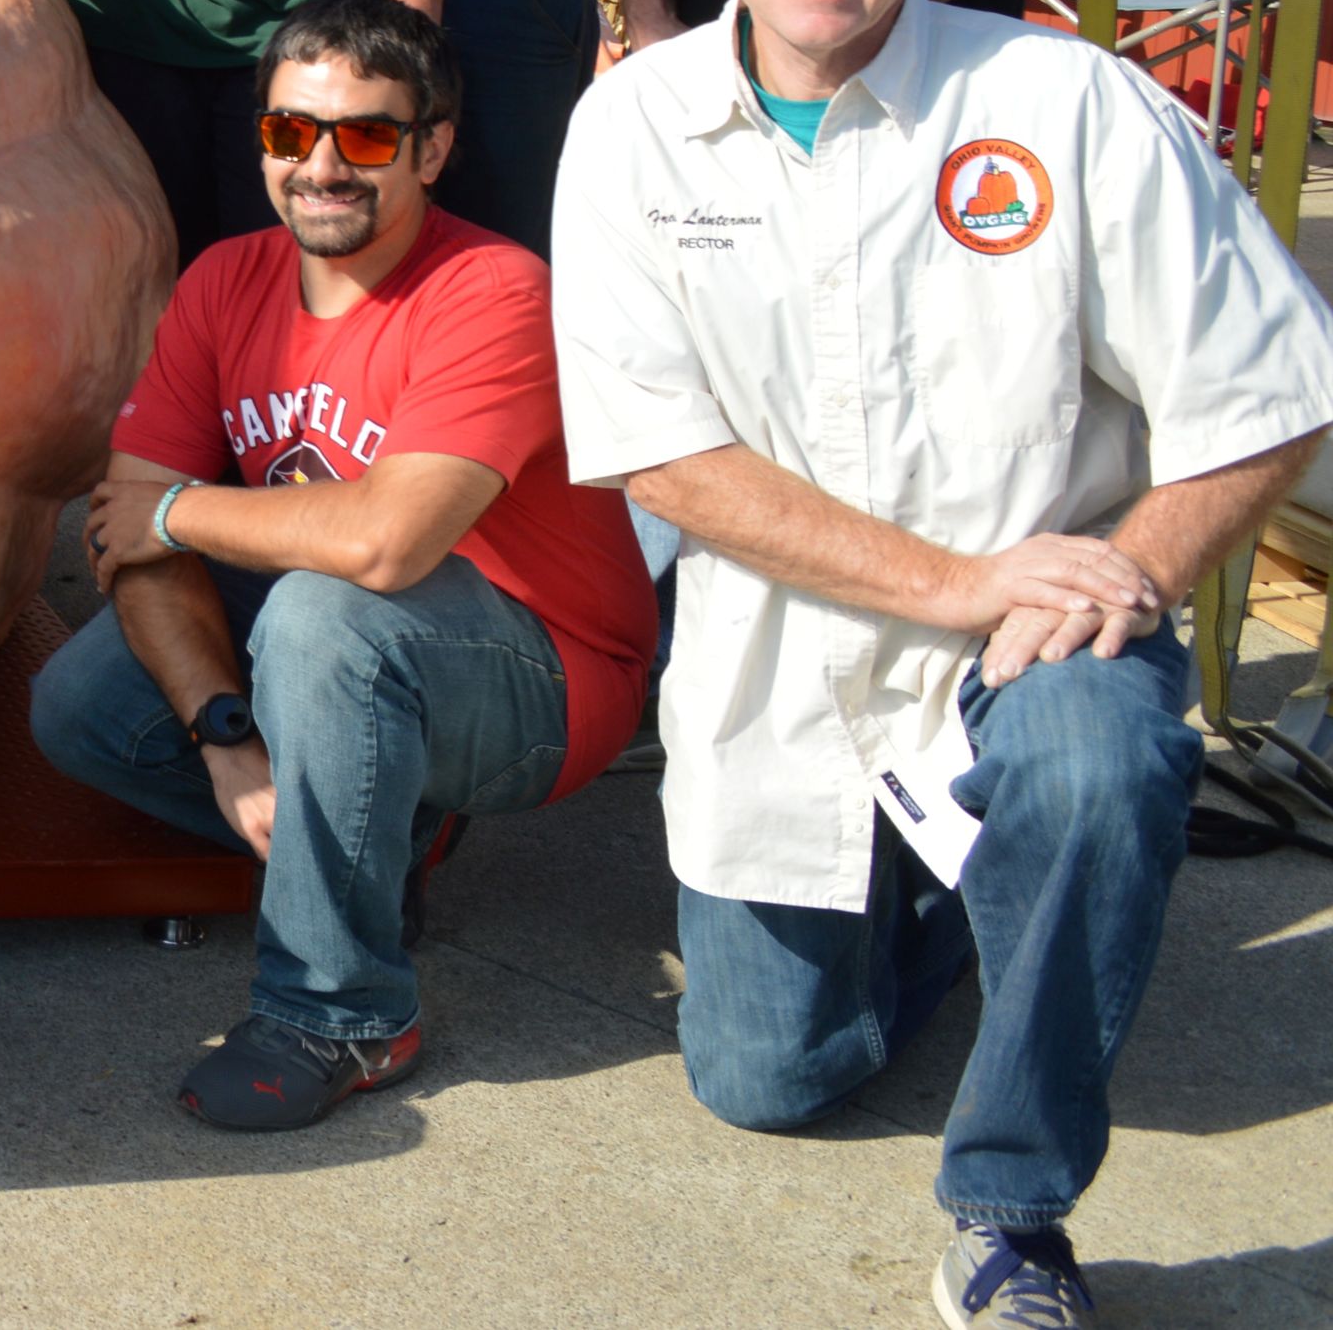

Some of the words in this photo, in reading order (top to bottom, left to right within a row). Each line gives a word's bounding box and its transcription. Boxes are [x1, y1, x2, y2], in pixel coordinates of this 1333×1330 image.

[951, 147, 981, 171] OHIO
[986, 145, 1036, 170] VALLEY
[963, 214, 1025, 227] OVGPG
